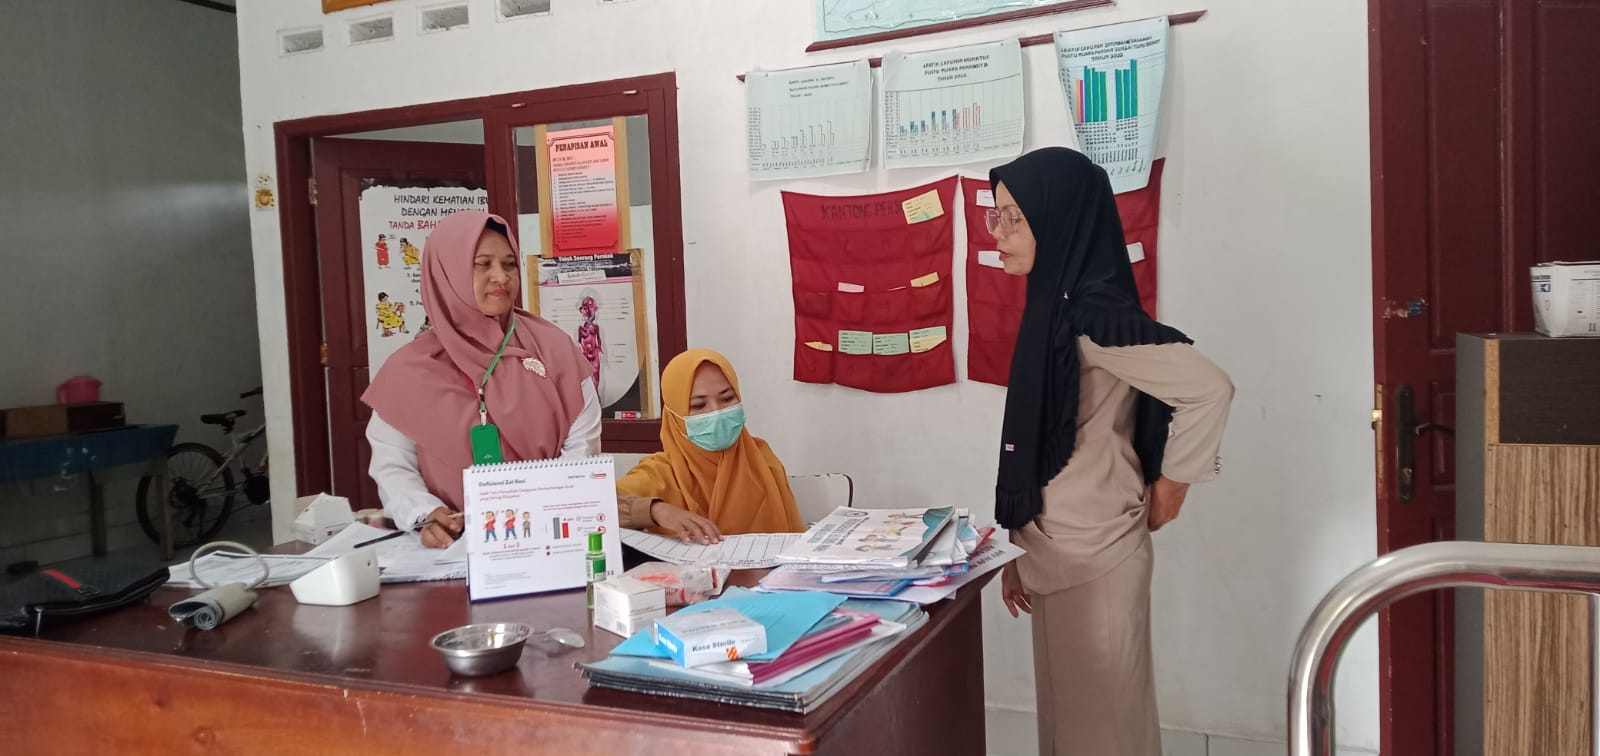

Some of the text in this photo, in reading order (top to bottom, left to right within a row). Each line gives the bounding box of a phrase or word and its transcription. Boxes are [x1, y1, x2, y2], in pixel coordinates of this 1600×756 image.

[555, 139, 608, 152] PENAPISAN AWAL
[394, 195, 430, 204] HINDARI
[433, 195, 475, 205] KEMATIAN
[401, 208, 437, 217] DENGAN
[821, 203, 871, 220] KANTONG
[875, 199, 901, 216] PERS
[388, 220, 441, 230] TANDA BAH
[693, 640, 735, 652] Kasa Sterile
